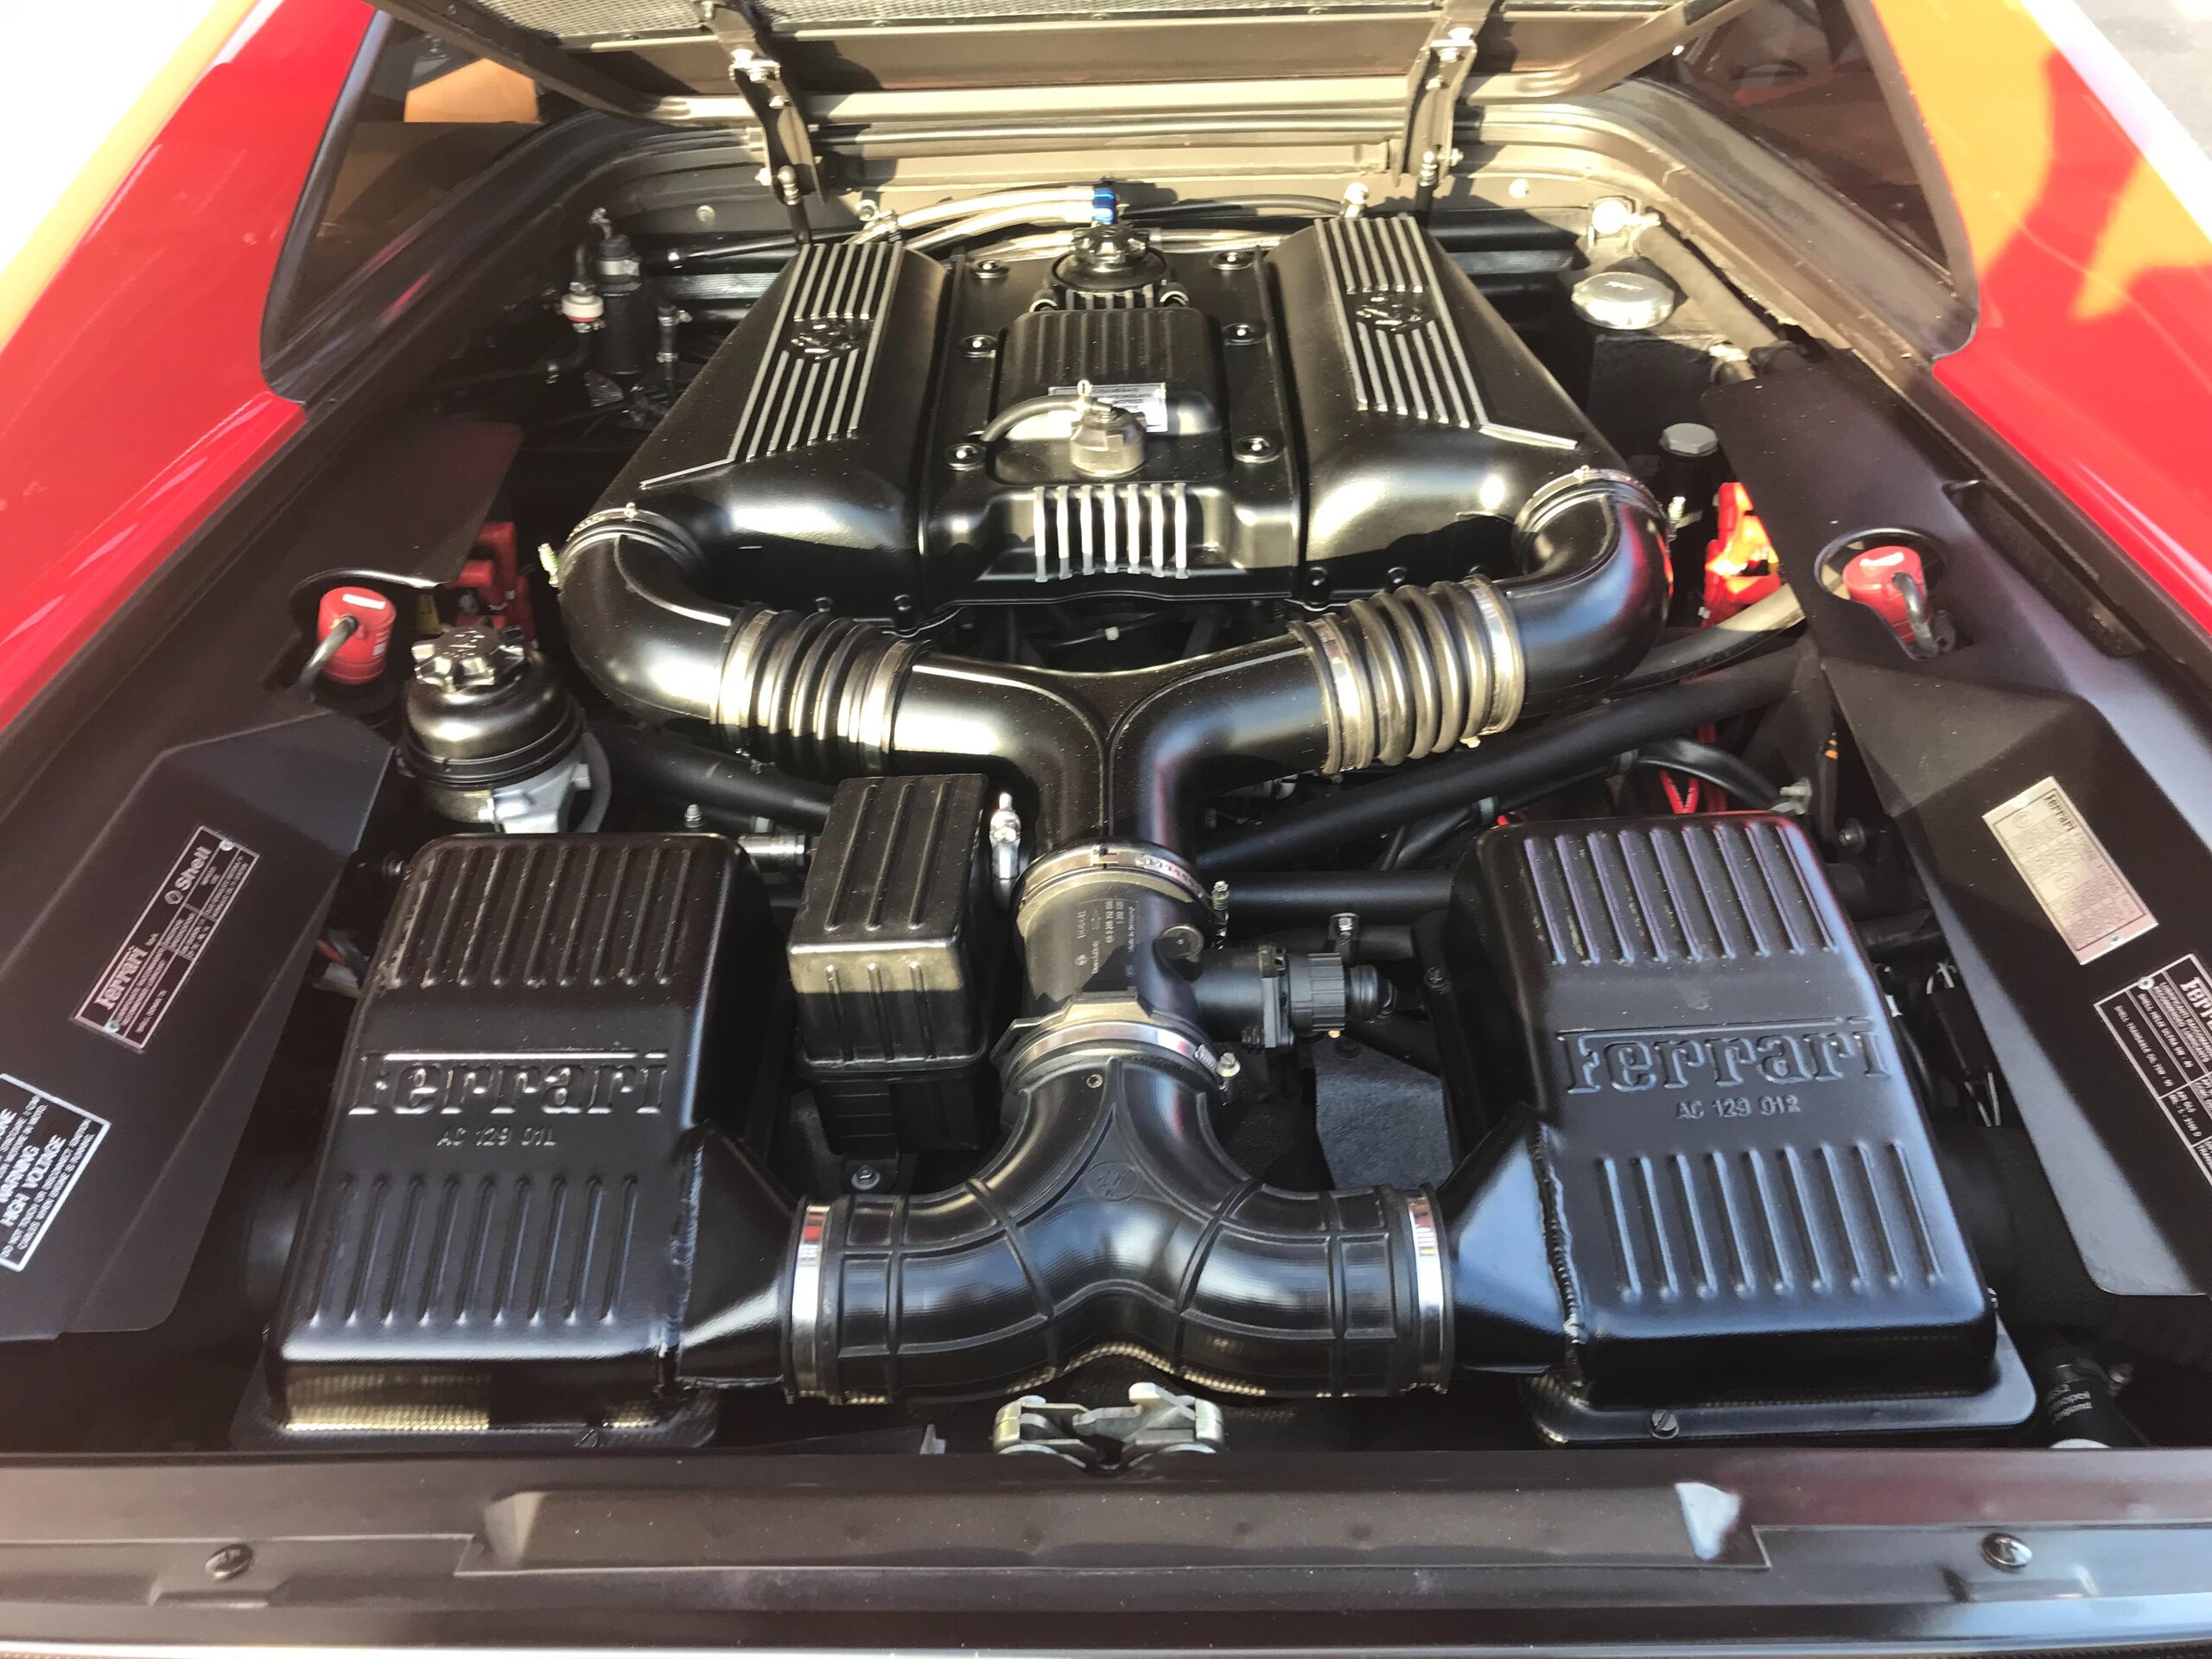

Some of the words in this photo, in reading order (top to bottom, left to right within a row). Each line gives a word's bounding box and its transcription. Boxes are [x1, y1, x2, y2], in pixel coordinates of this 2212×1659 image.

[2044, 794, 2076, 831] Ferrari
[95, 946, 146, 1008] Ferrari
[175, 847, 211, 890] Shell
[347, 1049, 670, 1115] Ferrari
[1557, 1016, 1890, 1095] Ferrari
[436, 1126, 464, 1147] AC
[475, 1126, 511, 1147] 129
[1676, 1100, 1705, 1121] AC
[1712, 1097, 1751, 1117] 129
[0, 1146, 38, 1202] WARNING
[0, 1193, 29, 1225] HIGH
[22, 1135, 65, 1187] VOLTAGE
